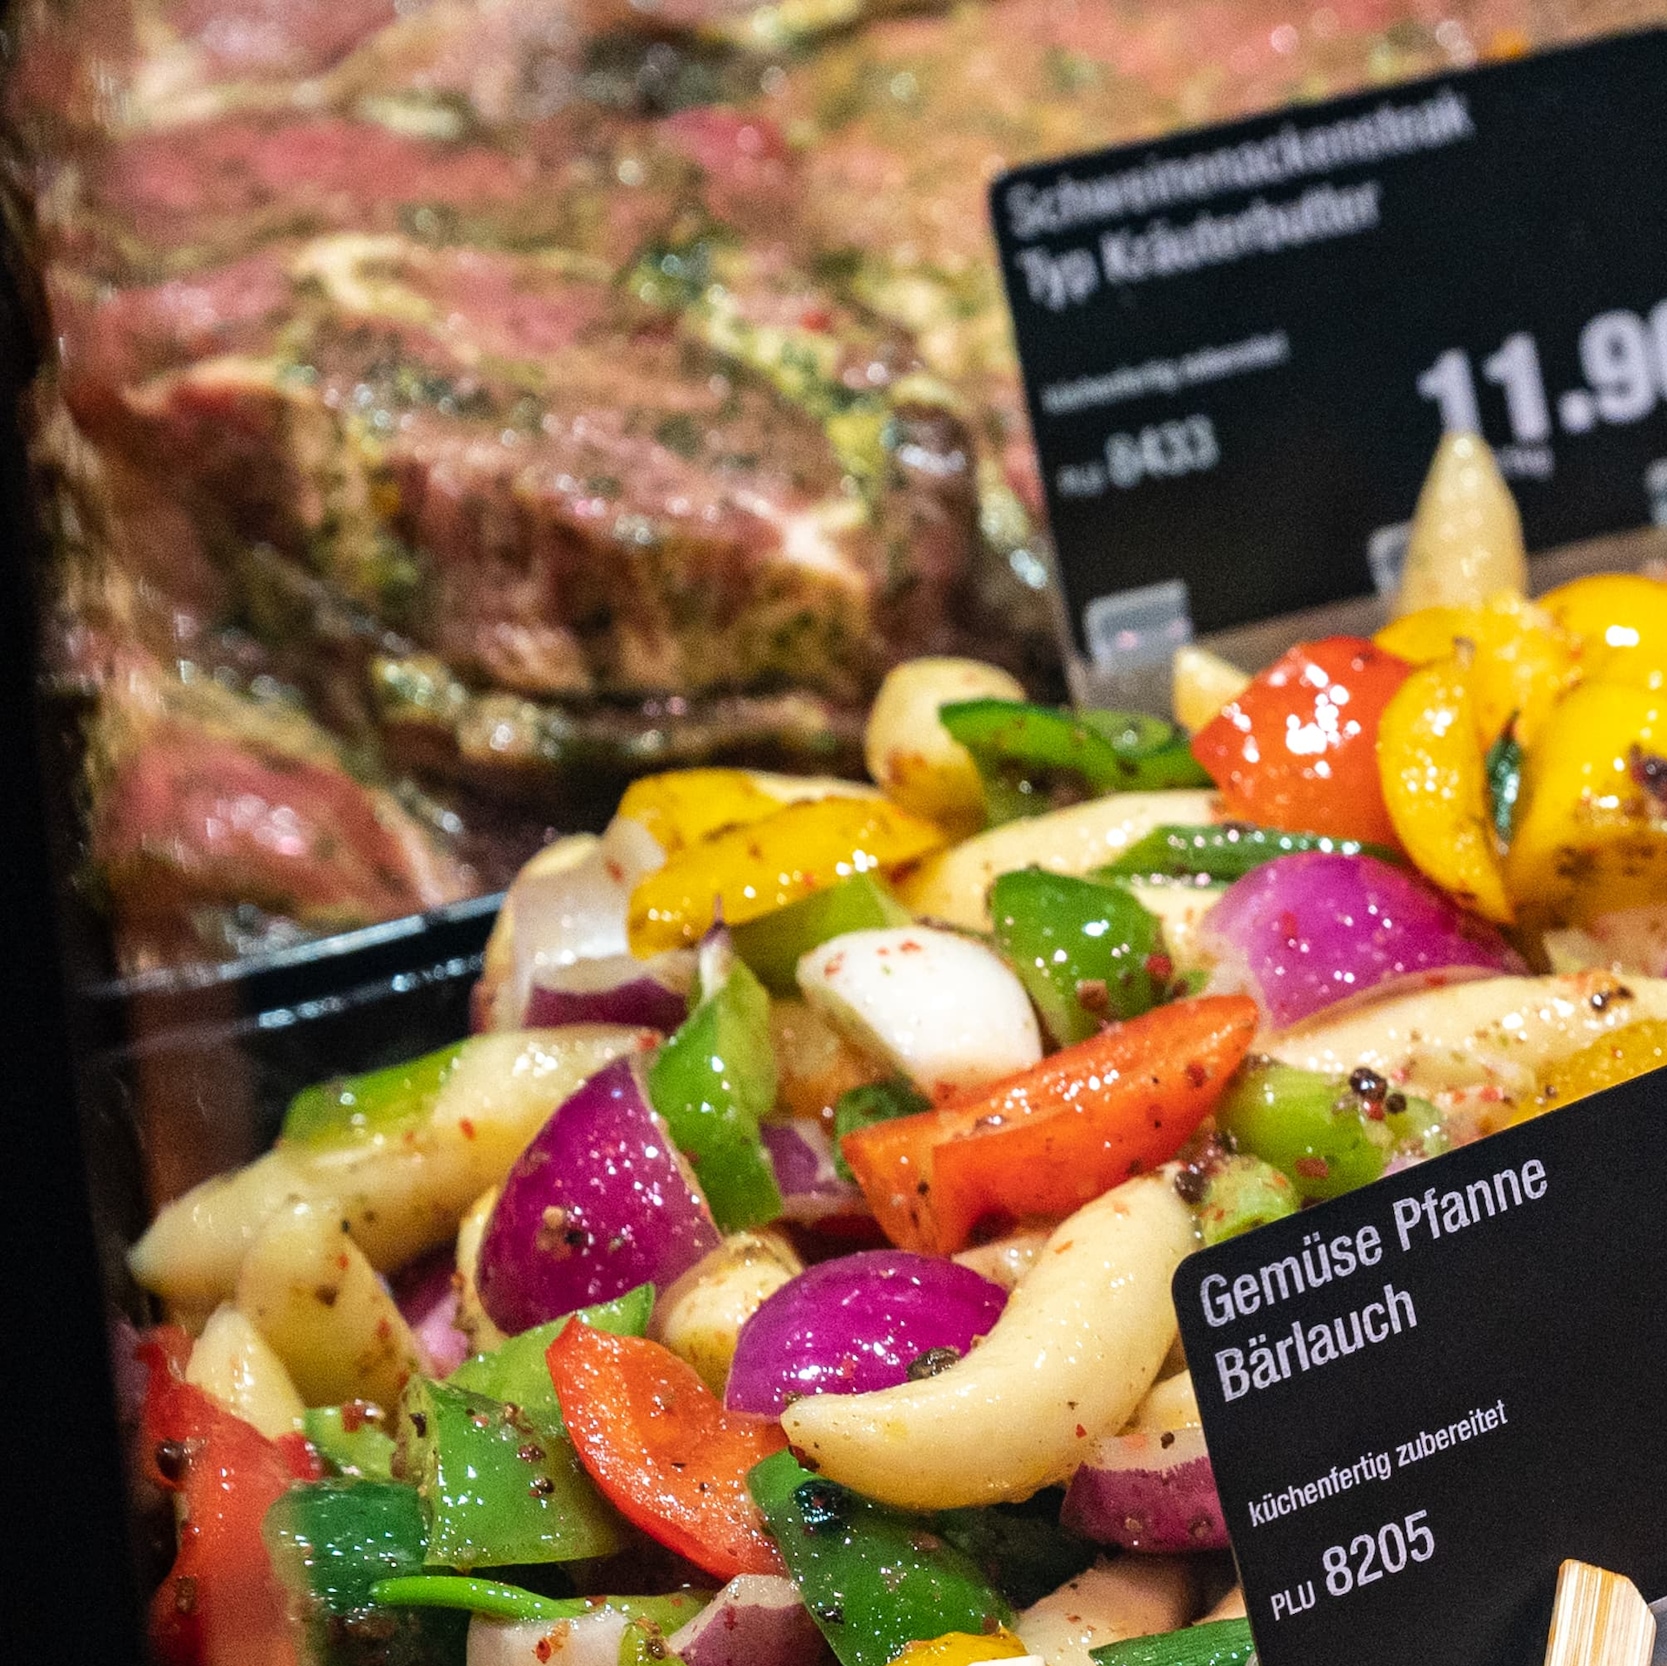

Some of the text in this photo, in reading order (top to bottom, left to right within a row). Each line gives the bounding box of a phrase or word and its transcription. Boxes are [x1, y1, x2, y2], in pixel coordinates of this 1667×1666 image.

[1006, 88, 1474, 240] Schweinenackensteak
[1017, 182, 1381, 310] Typ Kräuterbutter
[1200, 1159, 1548, 1327] Gemüse Pfanne
[1214, 1283, 1418, 1402] Bärlauch
[1248, 1399, 1508, 1527] küchenfertig zubereitet
[1270, 1509, 1436, 1621] PLU 8205
